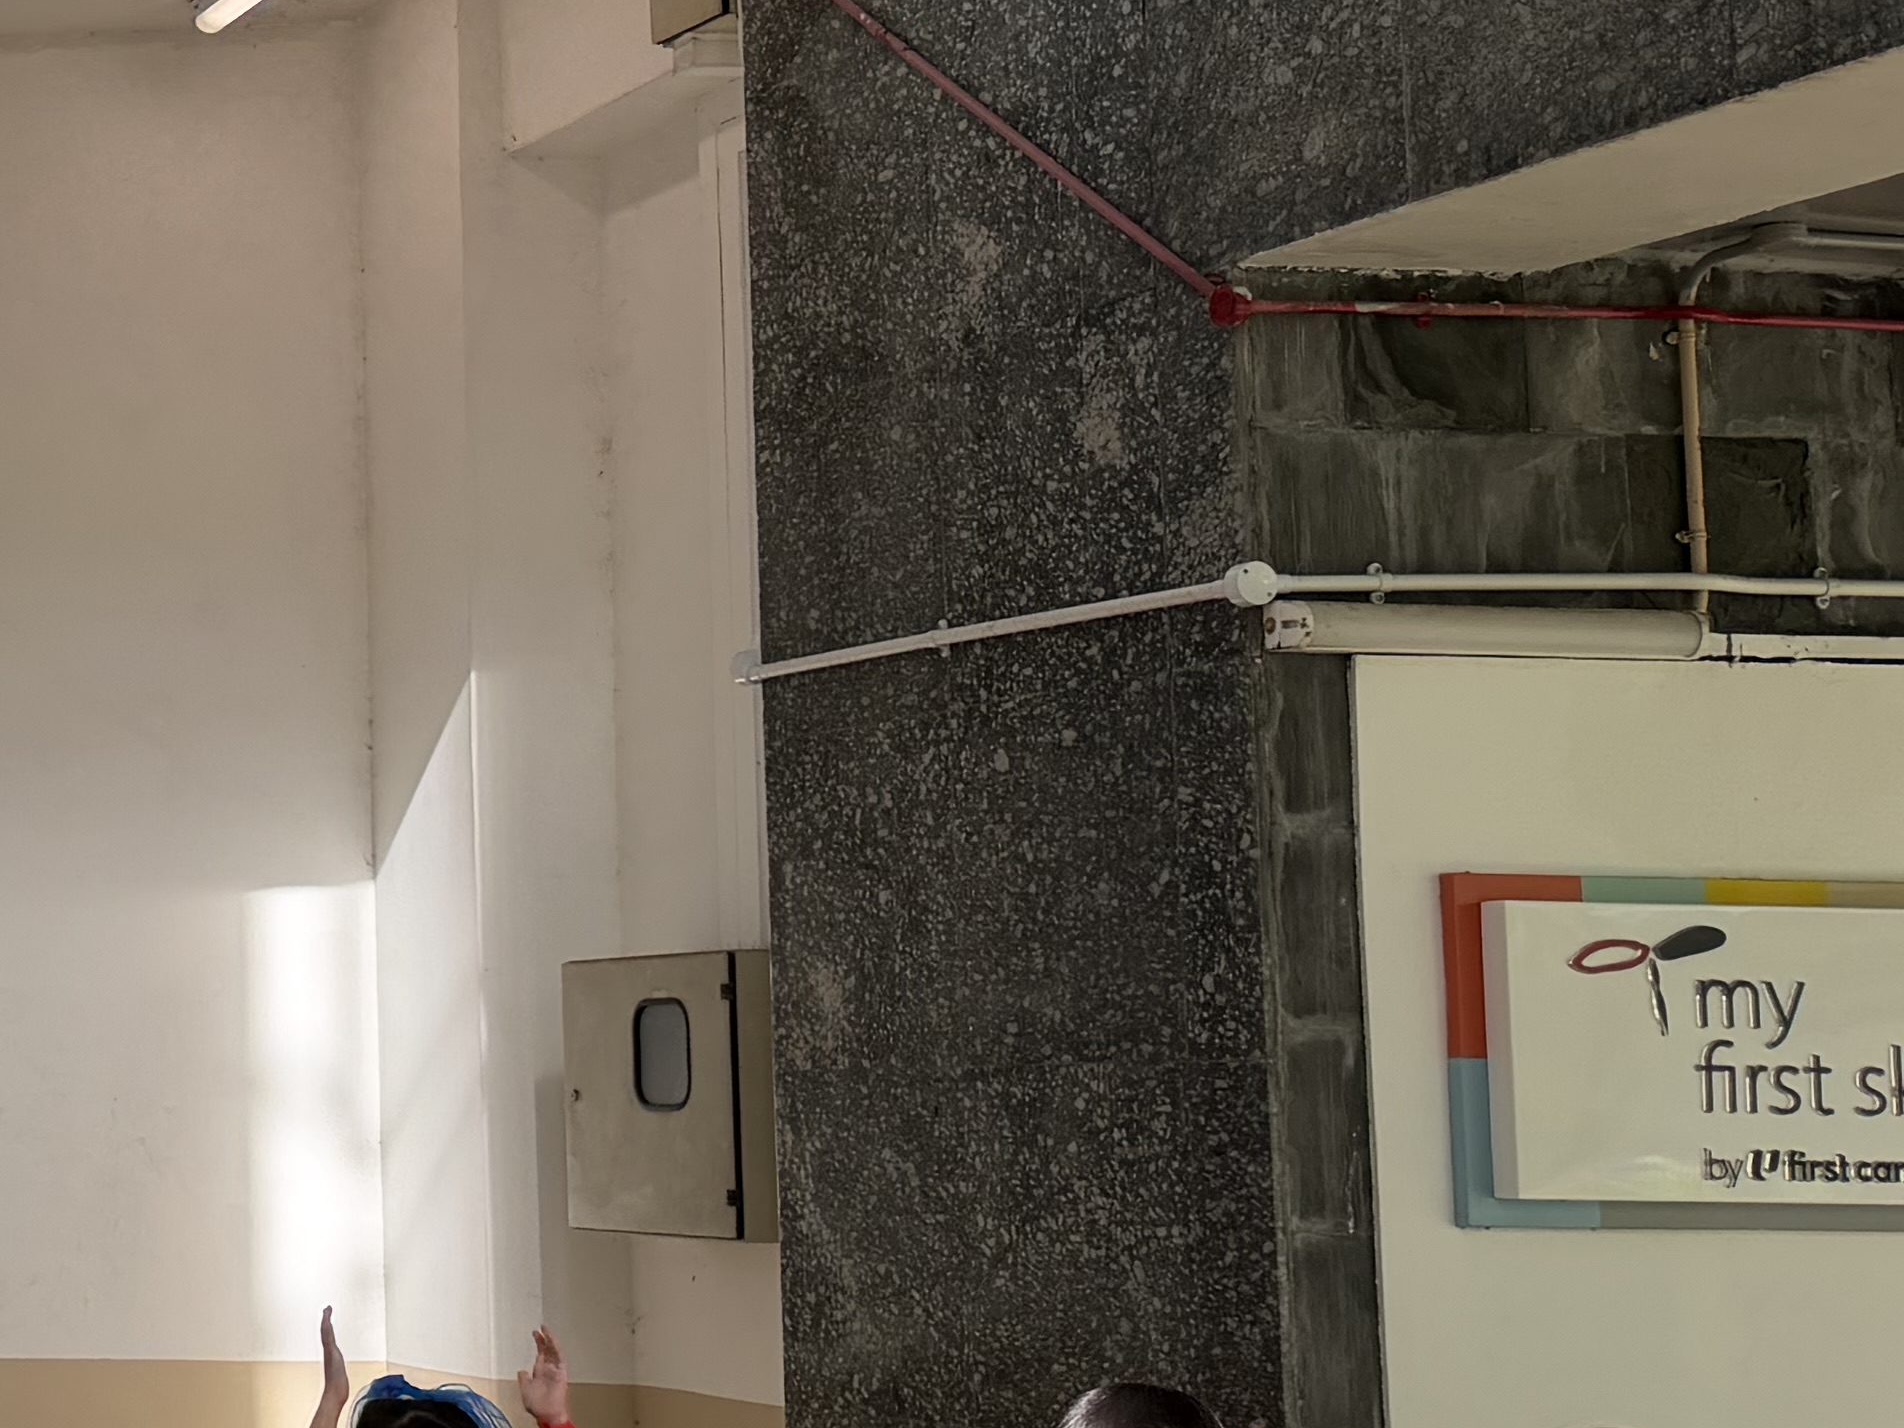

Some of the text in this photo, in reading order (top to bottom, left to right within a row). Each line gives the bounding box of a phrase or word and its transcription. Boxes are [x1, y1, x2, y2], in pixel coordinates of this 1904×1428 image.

[1694, 978, 1805, 1049] my
[1694, 1039, 1835, 1117] first
[1702, 1147, 1743, 1188] by
